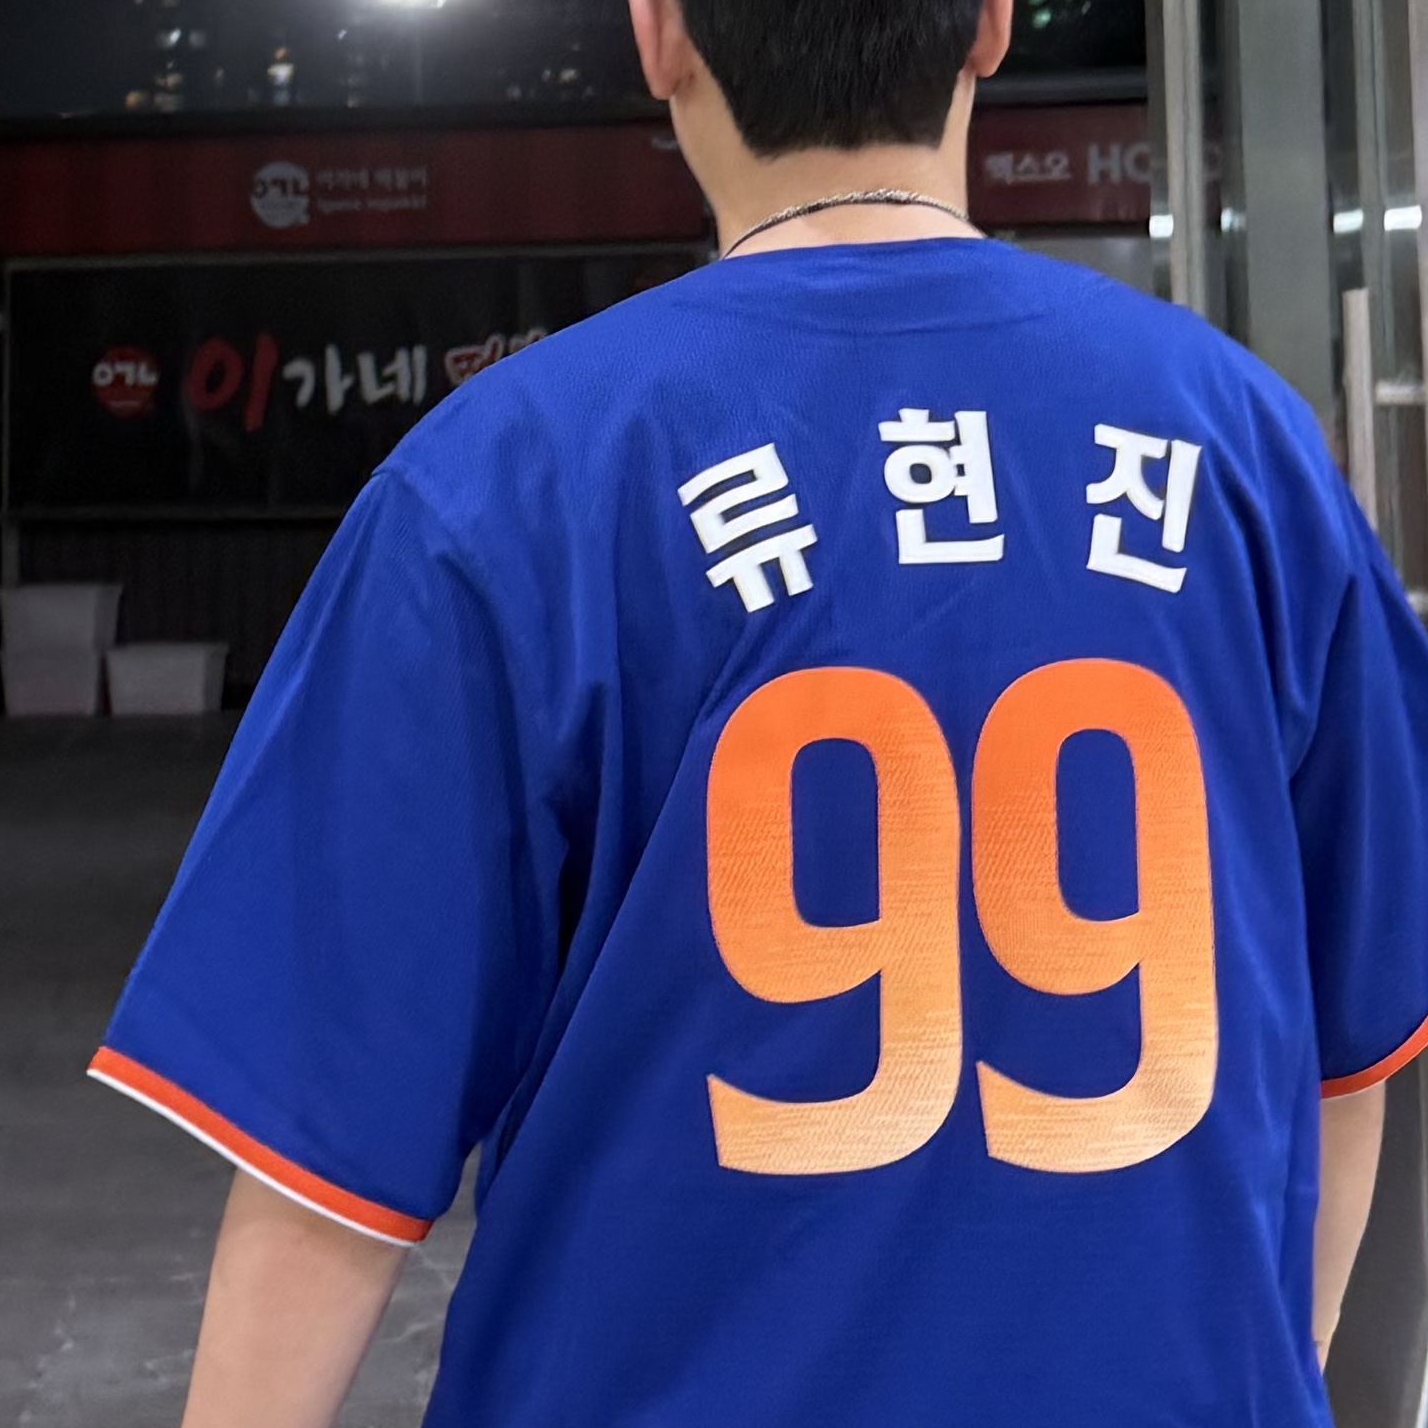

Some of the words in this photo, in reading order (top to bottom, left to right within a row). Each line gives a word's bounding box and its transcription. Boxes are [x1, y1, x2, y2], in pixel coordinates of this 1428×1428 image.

[184, 332, 429, 434] 이가네
[677, 408, 1203, 613] 류현진
[706, 657, 1219, 1175] 99
